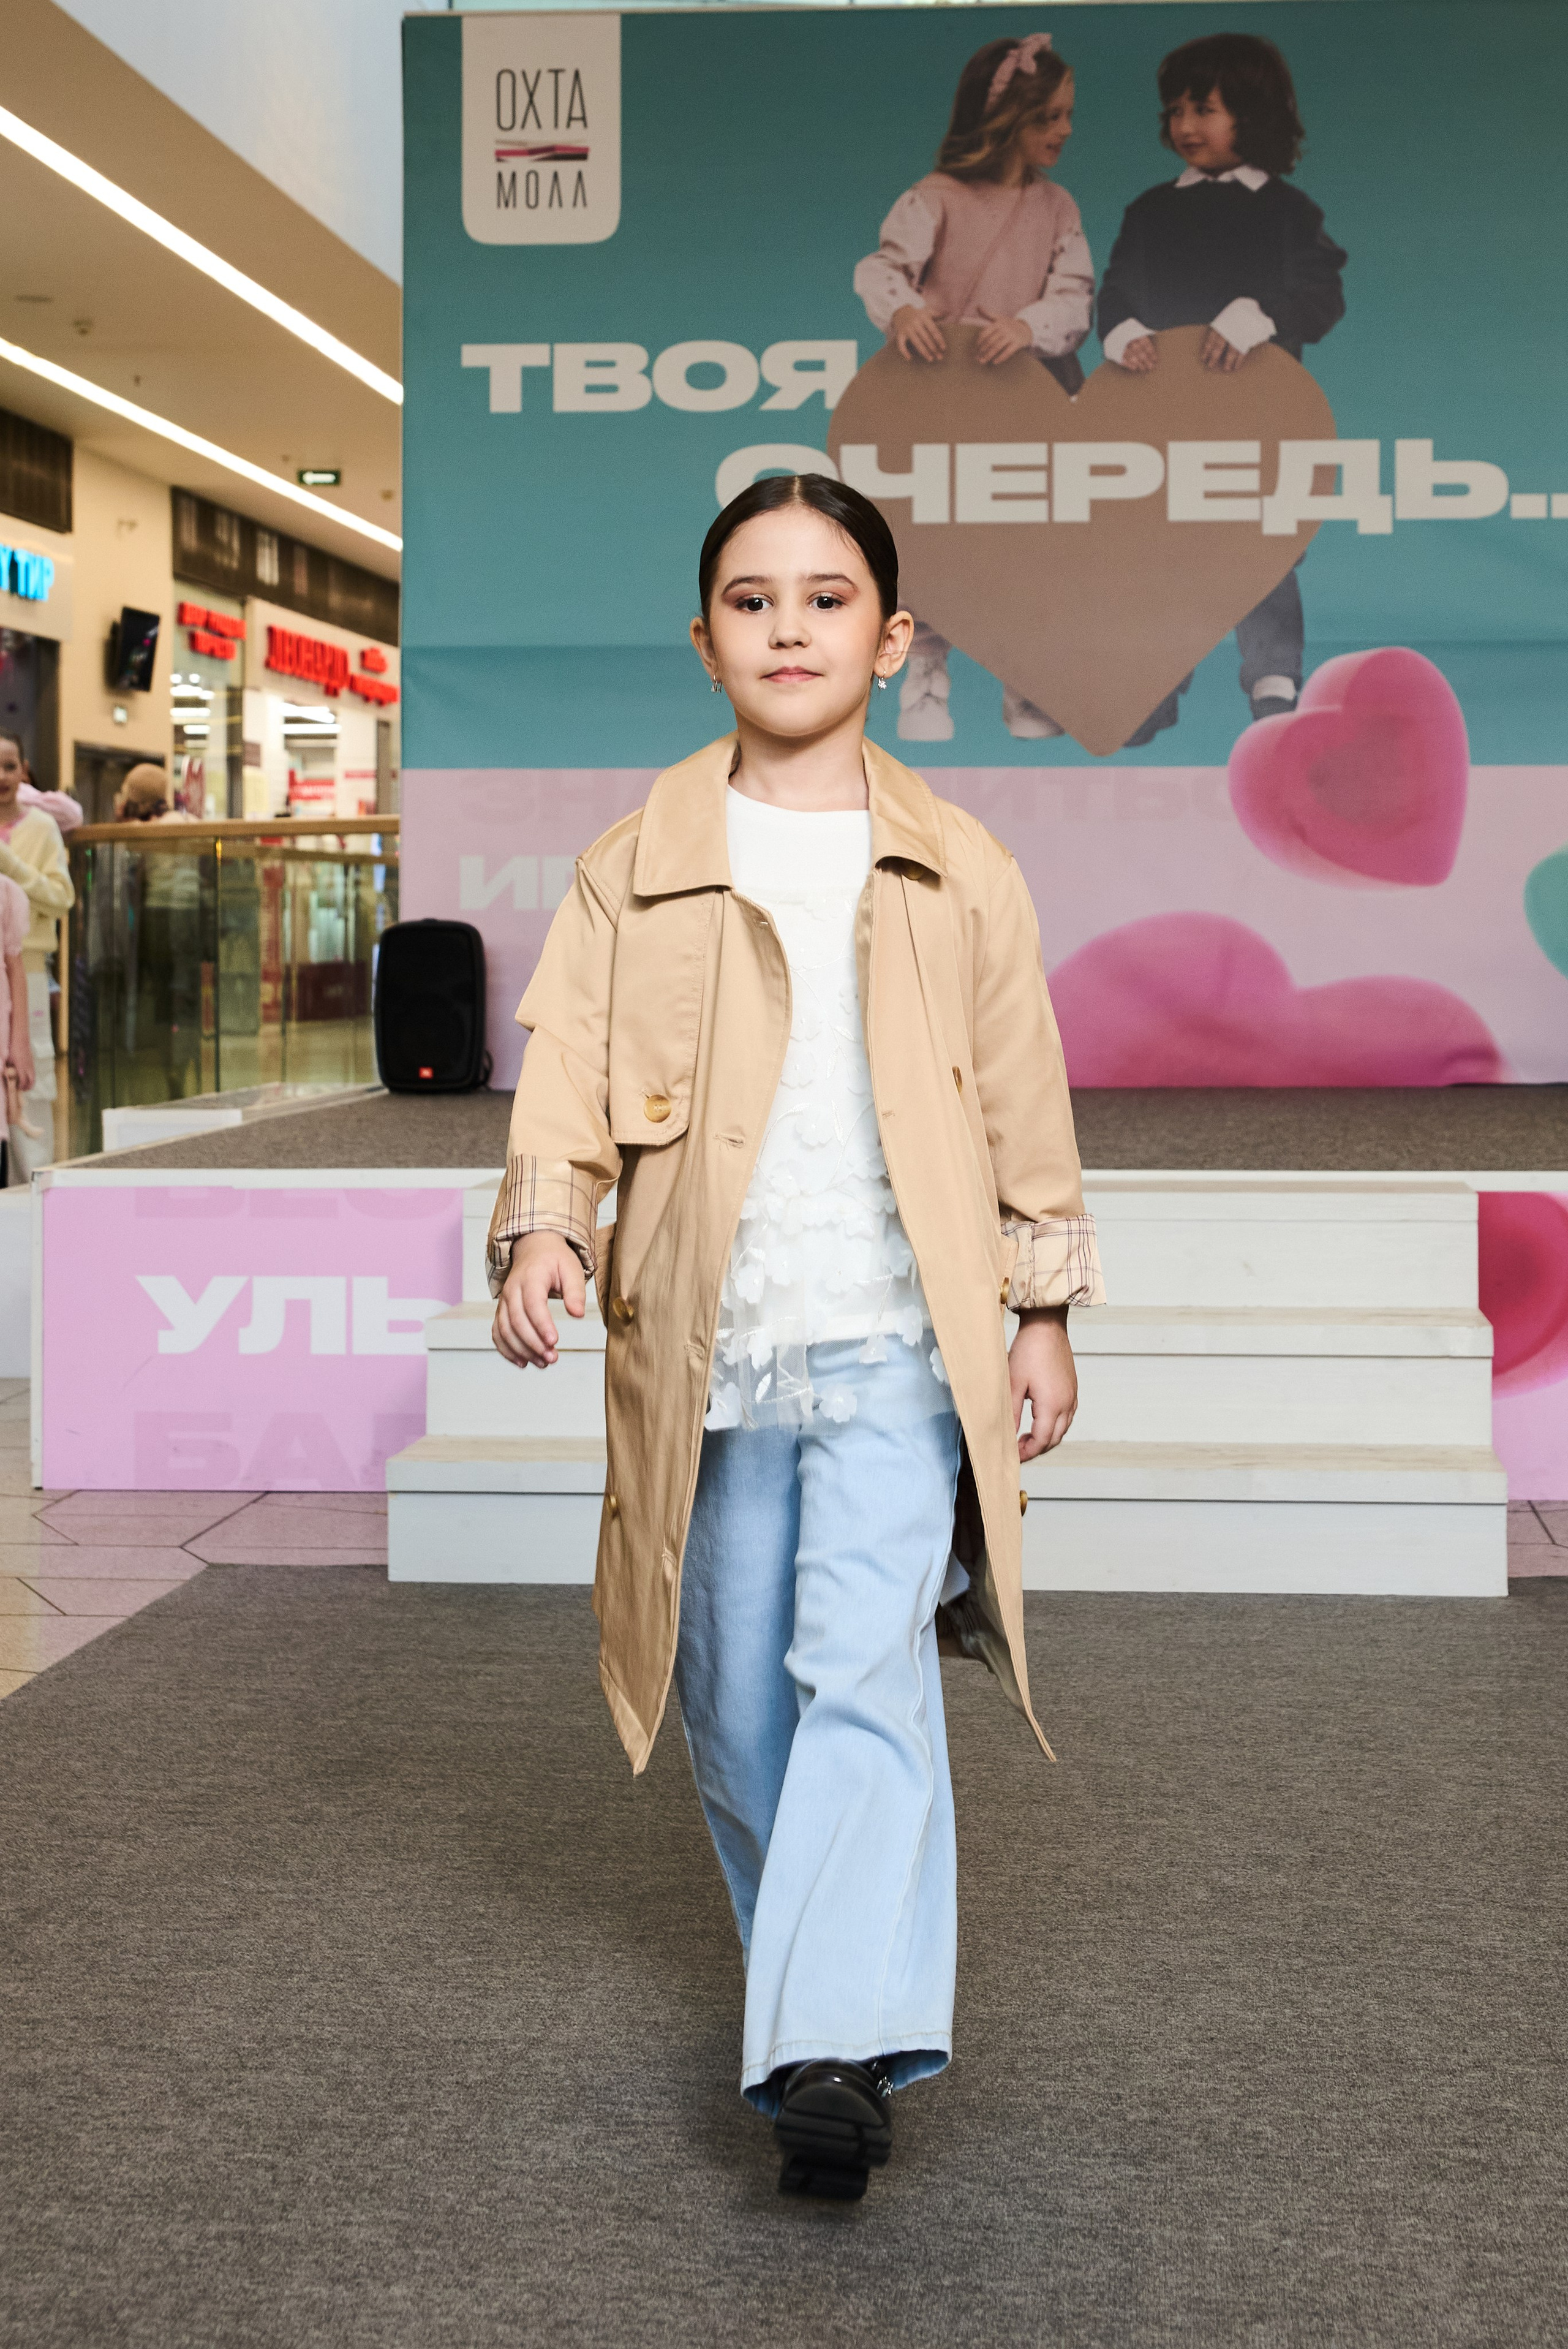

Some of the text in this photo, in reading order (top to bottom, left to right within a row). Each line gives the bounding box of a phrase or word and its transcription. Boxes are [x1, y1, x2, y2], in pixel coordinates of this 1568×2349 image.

[495, 68, 588, 131] ОХТА
[496, 170, 587, 210] МОЛЛ
[461, 339, 858, 414] ТВОЯ
